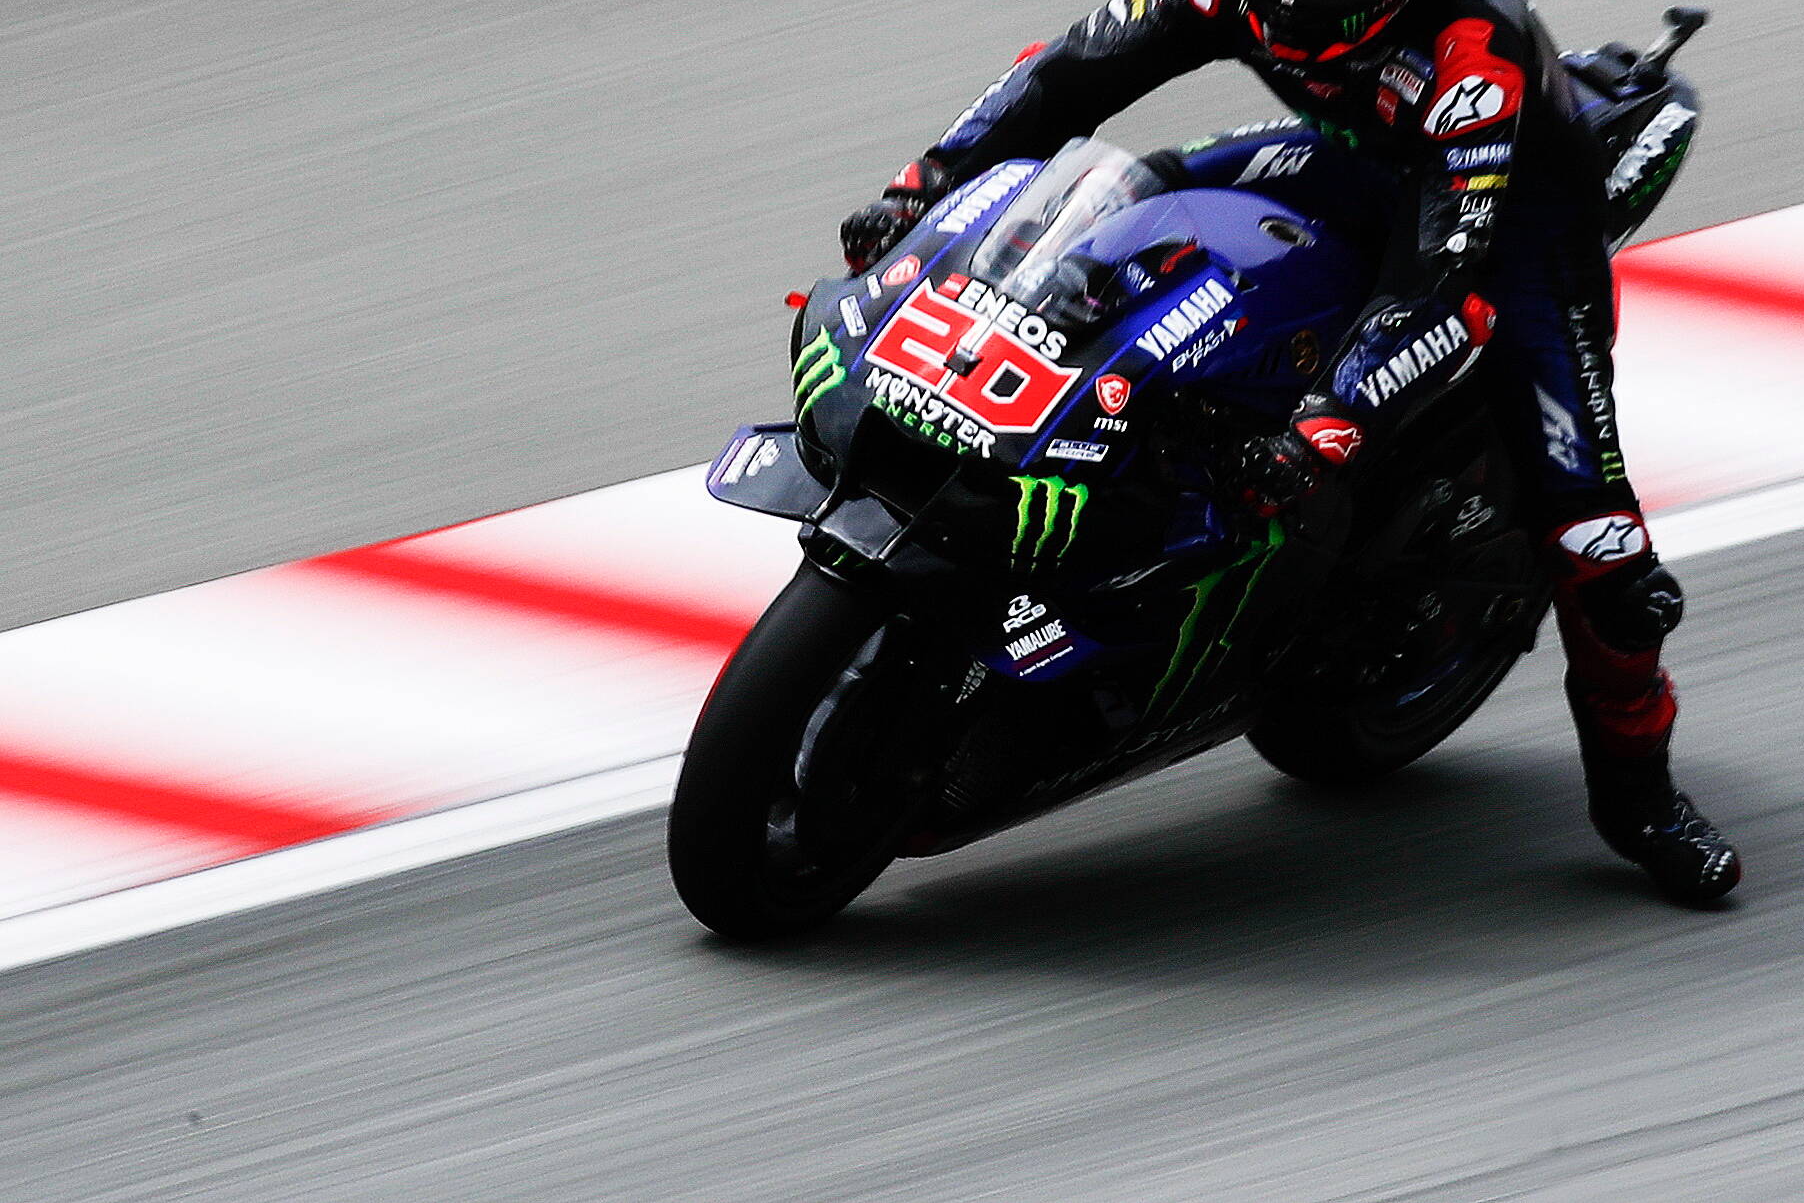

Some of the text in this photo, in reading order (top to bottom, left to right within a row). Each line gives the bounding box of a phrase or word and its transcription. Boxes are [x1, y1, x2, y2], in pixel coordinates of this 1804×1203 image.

[863, 276, 1084, 434] 20
[957, 278, 1068, 361] ENEOS
[1135, 277, 1234, 361] YAMAHA
[1355, 314, 1469, 408] YAMAHA
[865, 367, 997, 458] MONSTER
[872, 395, 970, 455] ENERGY
[1002, 603, 1047, 634] RCB
[1004, 618, 1067, 661] YAMALUBE
